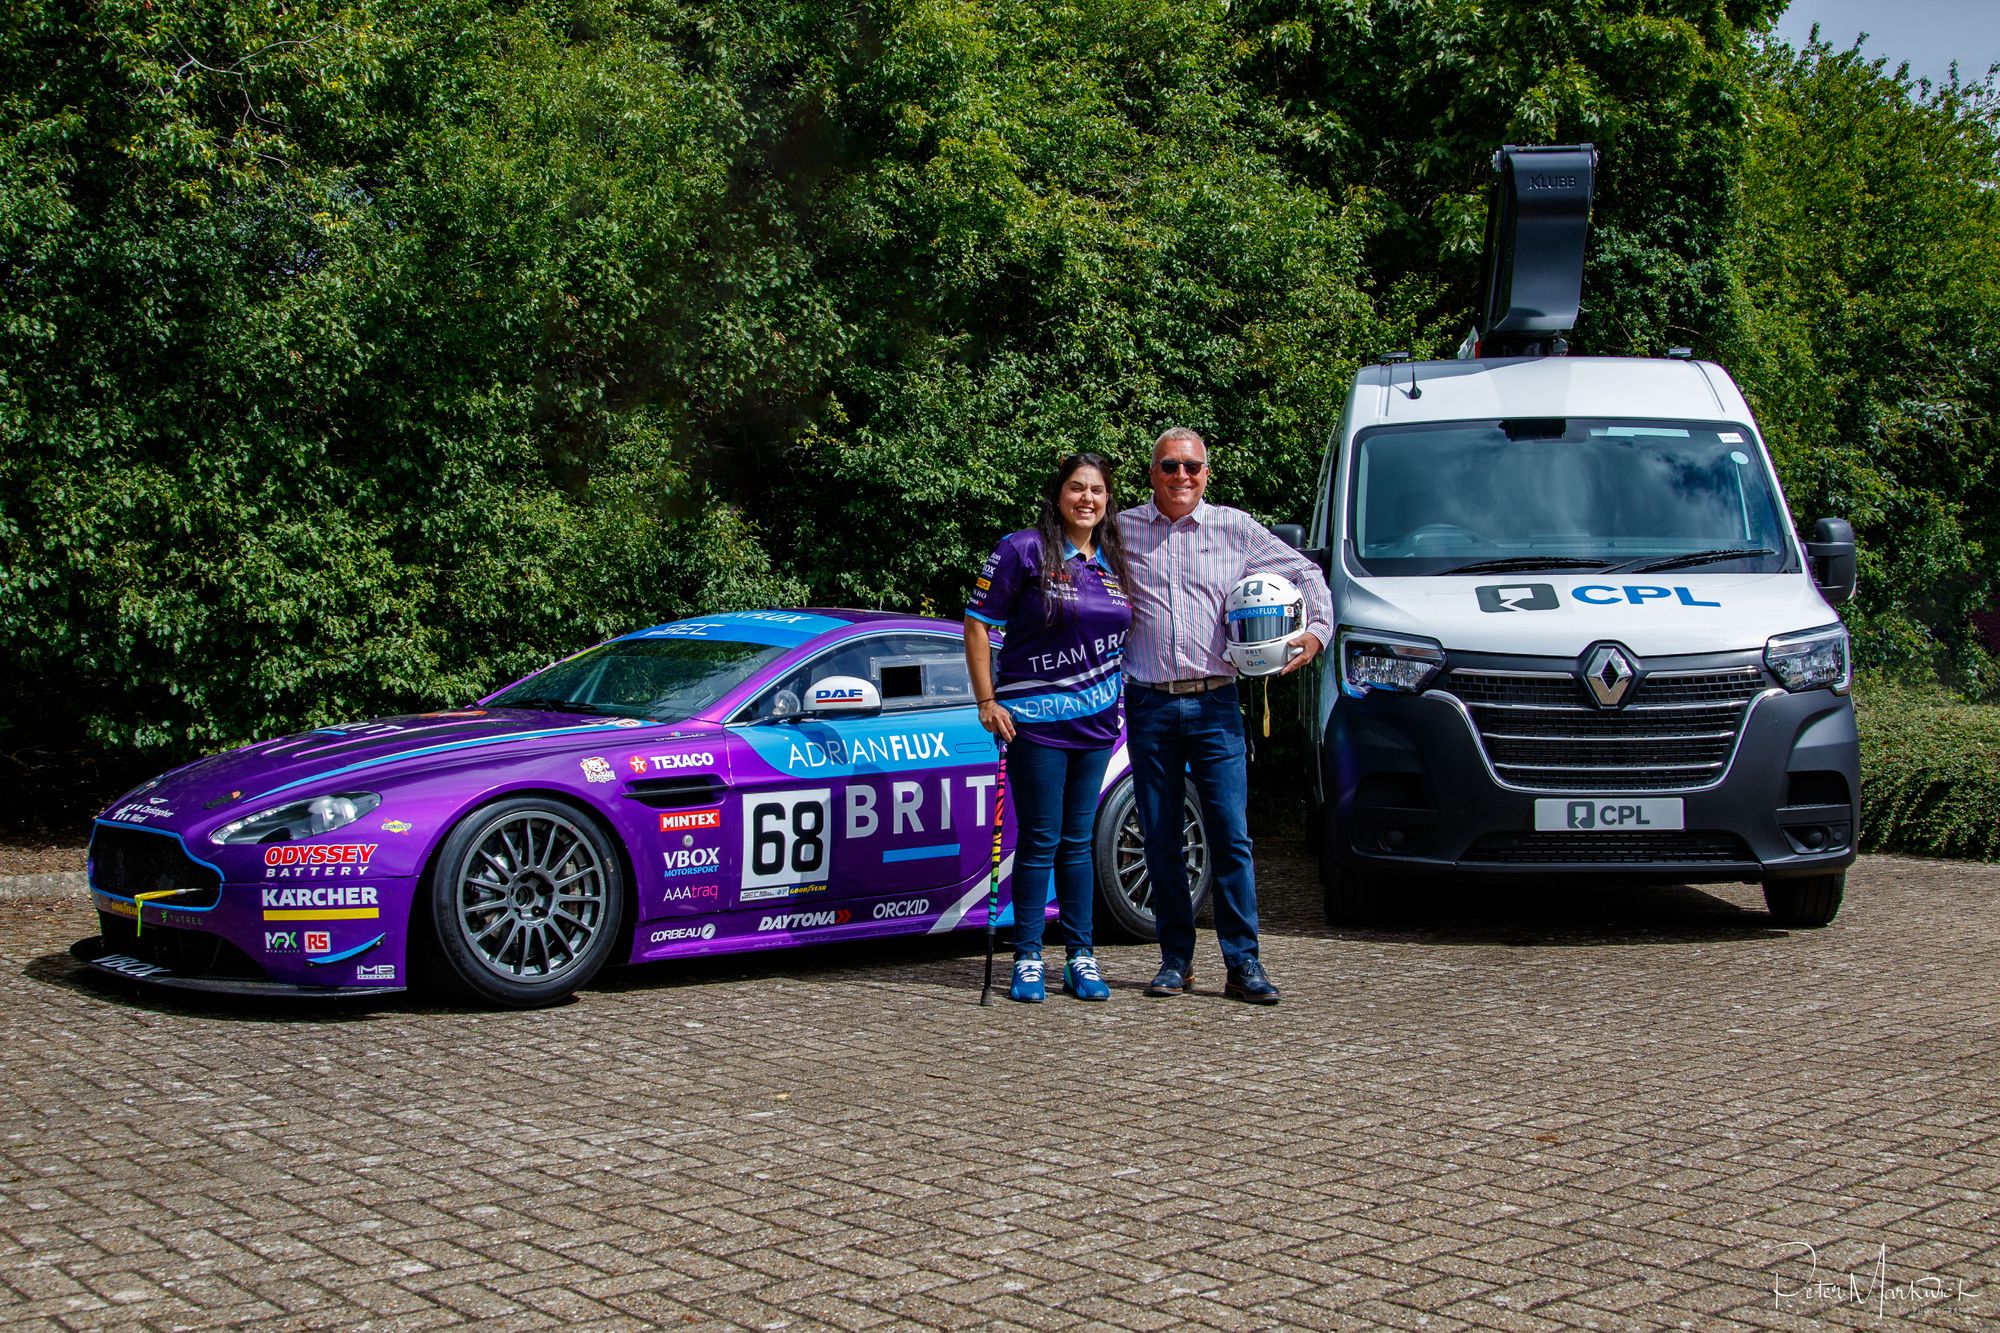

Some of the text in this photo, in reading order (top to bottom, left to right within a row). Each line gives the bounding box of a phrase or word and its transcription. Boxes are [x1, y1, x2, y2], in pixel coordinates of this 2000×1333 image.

[1527, 172, 1577, 190] KLUBB
[1571, 585, 1722, 608] CPL
[1232, 607, 1278, 618] ADRIANFLUX
[1028, 628, 1129, 673] TEAM BRI
[815, 689, 863, 699] DAF
[789, 732, 950, 769] ADRIANFLUX
[651, 752, 714, 770] TEXACO
[845, 774, 996, 839] BRIT
[1600, 805, 1651, 825] CPL
[662, 812, 716, 829] MINTEX
[752, 800, 824, 876] 68
[265, 844, 378, 866] ODYSSEY
[663, 847, 720, 869] VBOX
[266, 866, 369, 878] BATTERY
[664, 865, 719, 878] MOTORSPORT
[262, 887, 379, 907] KÄRCHER
[663, 885, 718, 902] AAAtraq
[789, 884, 827, 895] GOODYEAR
[758, 910, 836, 931] DAYTONA
[307, 933, 329, 950] RS
[651, 926, 701, 943] CORBEAU
[92, 954, 173, 977] VBOX
